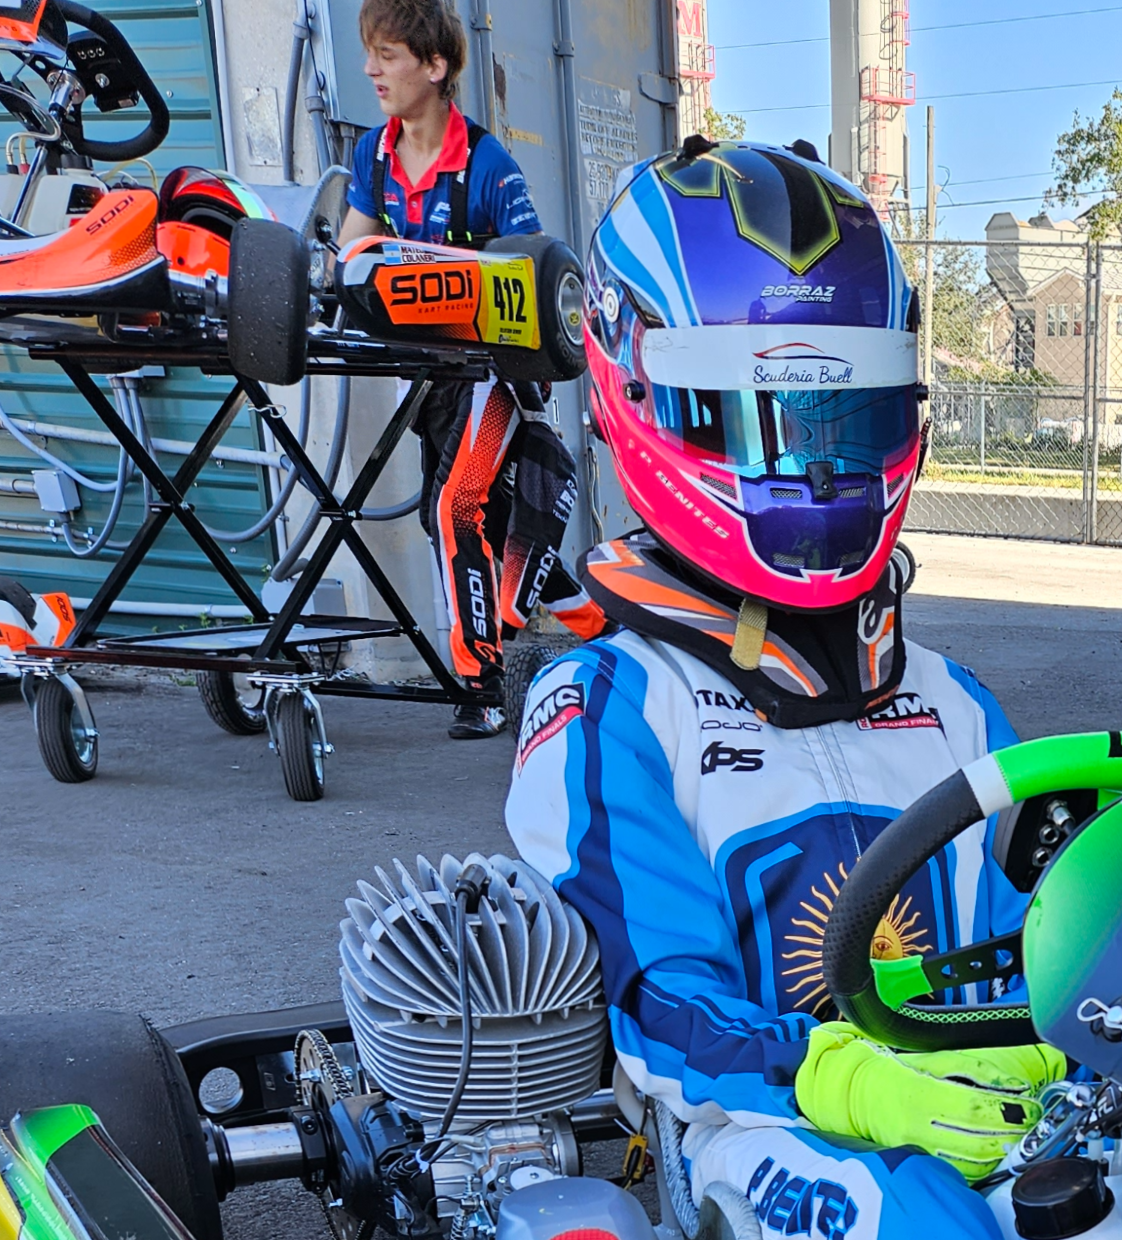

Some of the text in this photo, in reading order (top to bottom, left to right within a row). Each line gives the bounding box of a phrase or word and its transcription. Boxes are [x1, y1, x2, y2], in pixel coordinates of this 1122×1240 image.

[492, 274, 527, 323] 412
[761, 284, 836, 298] BORRAZ
[795, 296, 832, 304] PAINTING
[753, 364, 853, 384] Scuderia Buell
[696, 690, 757, 715] TAX
[871, 696, 937, 719] RM
[521, 687, 581, 751] RMC
[542, 714, 568, 739] FINALS
[701, 719, 763, 733] OJO
[874, 720, 909, 728] GRAND
